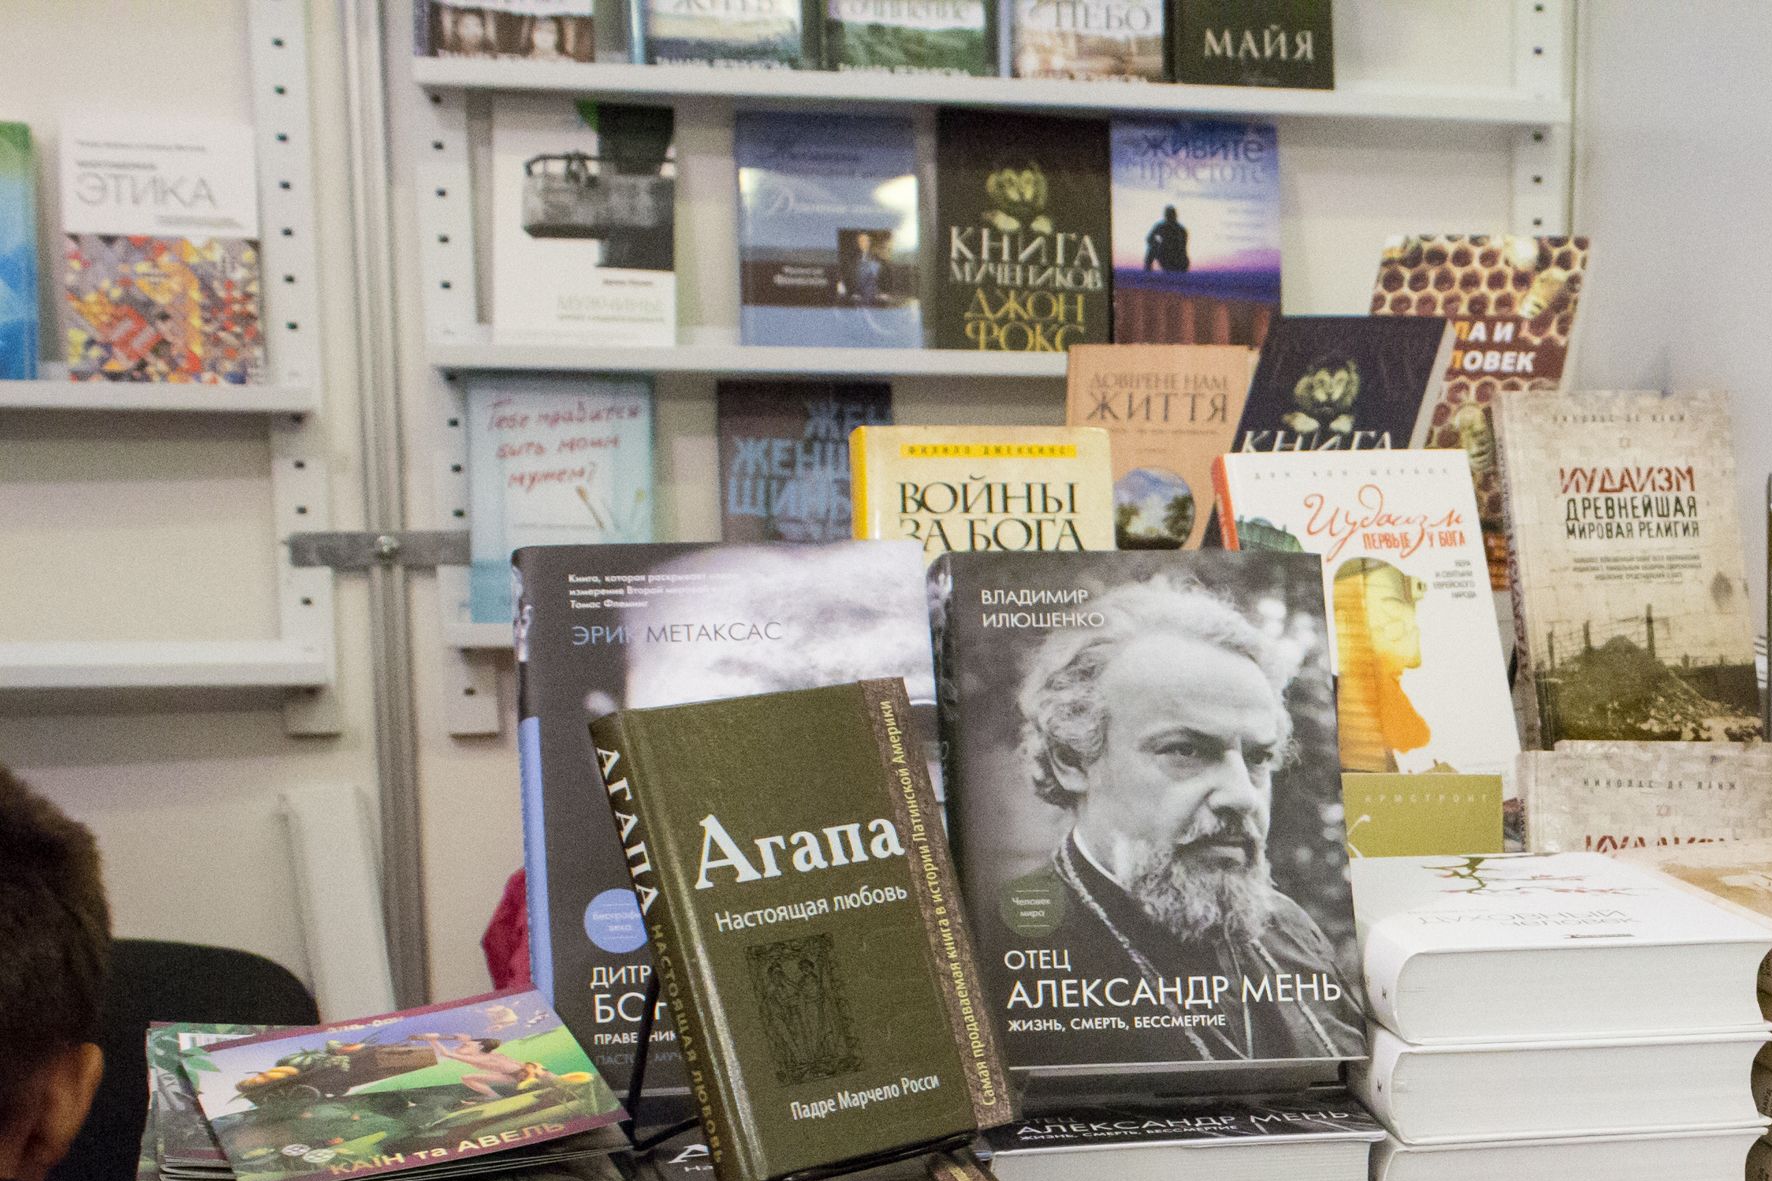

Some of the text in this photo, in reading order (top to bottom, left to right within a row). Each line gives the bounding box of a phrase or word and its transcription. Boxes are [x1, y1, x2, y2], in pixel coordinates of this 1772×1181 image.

[1203, 24, 1315, 62] МАЙЯ
[76, 171, 218, 208] ЭТИКА
[950, 225, 1100, 268] КНИГА
[964, 288, 1085, 324] ДЖОН
[964, 320, 1085, 352] ФОКС
[1449, 349, 1535, 373] ЛОВЕК
[1087, 391, 1229, 423] ЖИТТЯ
[897, 474, 1080, 514] ВОЙНЫ
[1559, 465, 1696, 494] ИУДАИЗМ
[1303, 484, 1463, 562] Иудаизм
[1565, 495, 1698, 521] ДРЕВНЕЙШАЯ
[899, 518, 1086, 550] ЗА БОГА
[1362, 530, 1466, 550] ПЕРВЫЕ БОГА
[1566, 520, 1700, 540] МИРОВАЯ РЕЛИГИЯ
[567, 572, 646, 584] Книга, которая
[569, 599, 601, 609] Томас
[981, 589, 1089, 606] ВЛАДИМИР
[572, 621, 783, 646] ЭРИК МЕТАКСАС
[981, 612, 1105, 629] ИЛЮШЕНКО
[879, 700, 908, 766] Америки
[897, 768, 928, 842] Латинской
[596, 746, 660, 917] АГАПА
[694, 813, 906, 890] Агапа
[919, 844, 943, 905] истории
[714, 884, 908, 933] Настоящая любовь
[938, 917, 960, 958] книга
[590, 965, 652, 990] ДИТР
[1003, 949, 1072, 973] ОТЕЦ
[947, 957, 986, 1058] продаваемая
[1007, 972, 1342, 1010] АЛЕКСАНДР МЕНЬ
[1007, 1014, 1226, 1032] ЖИЗНЬ, СМЕРТЬ, БЕССМЕРТИЕ
[790, 1072, 941, 1121] Падре Марчело Росси
[976, 1060, 997, 1106] Самая
[412, 1146, 448, 1159] та
[456, 1121, 567, 1156] АВЕЛЬ
[1016, 1109, 1350, 1136] АЛЕКСАНДР МЕНЬ
